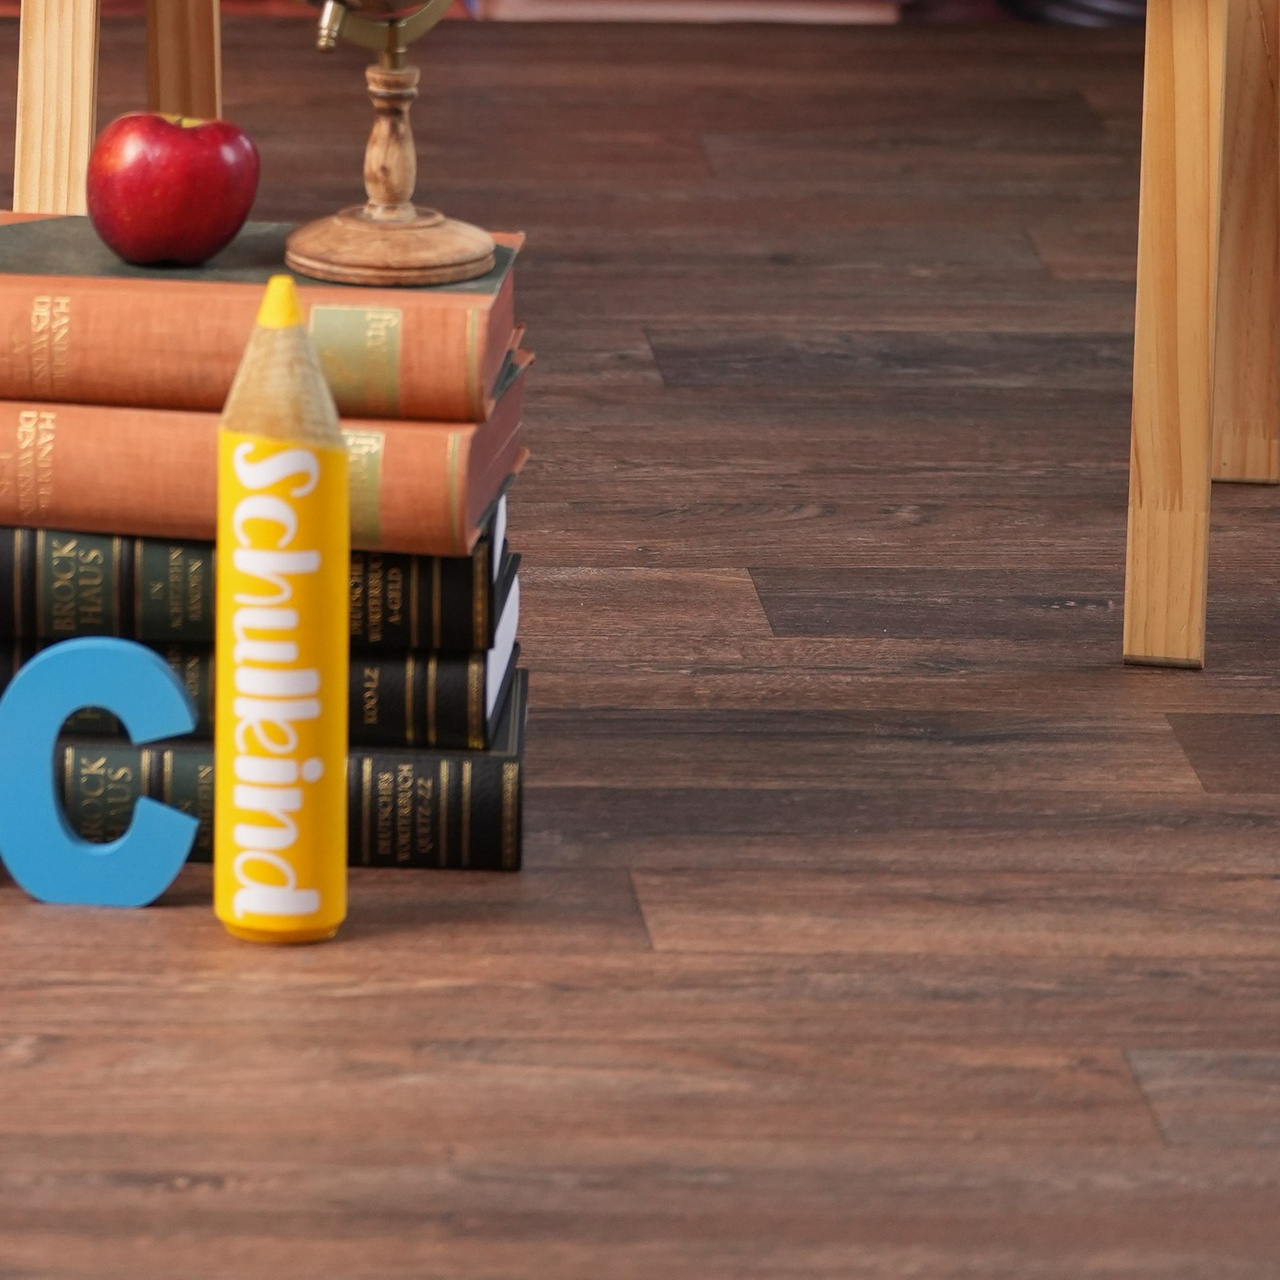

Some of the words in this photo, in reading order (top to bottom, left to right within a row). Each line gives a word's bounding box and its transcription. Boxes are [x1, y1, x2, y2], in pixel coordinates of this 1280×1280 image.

[51, 539, 78, 631] BROCK
[78, 548, 104, 625] HAUS
[232, 441, 324, 919] Schulkind
[80, 756, 106, 838] ROCK
